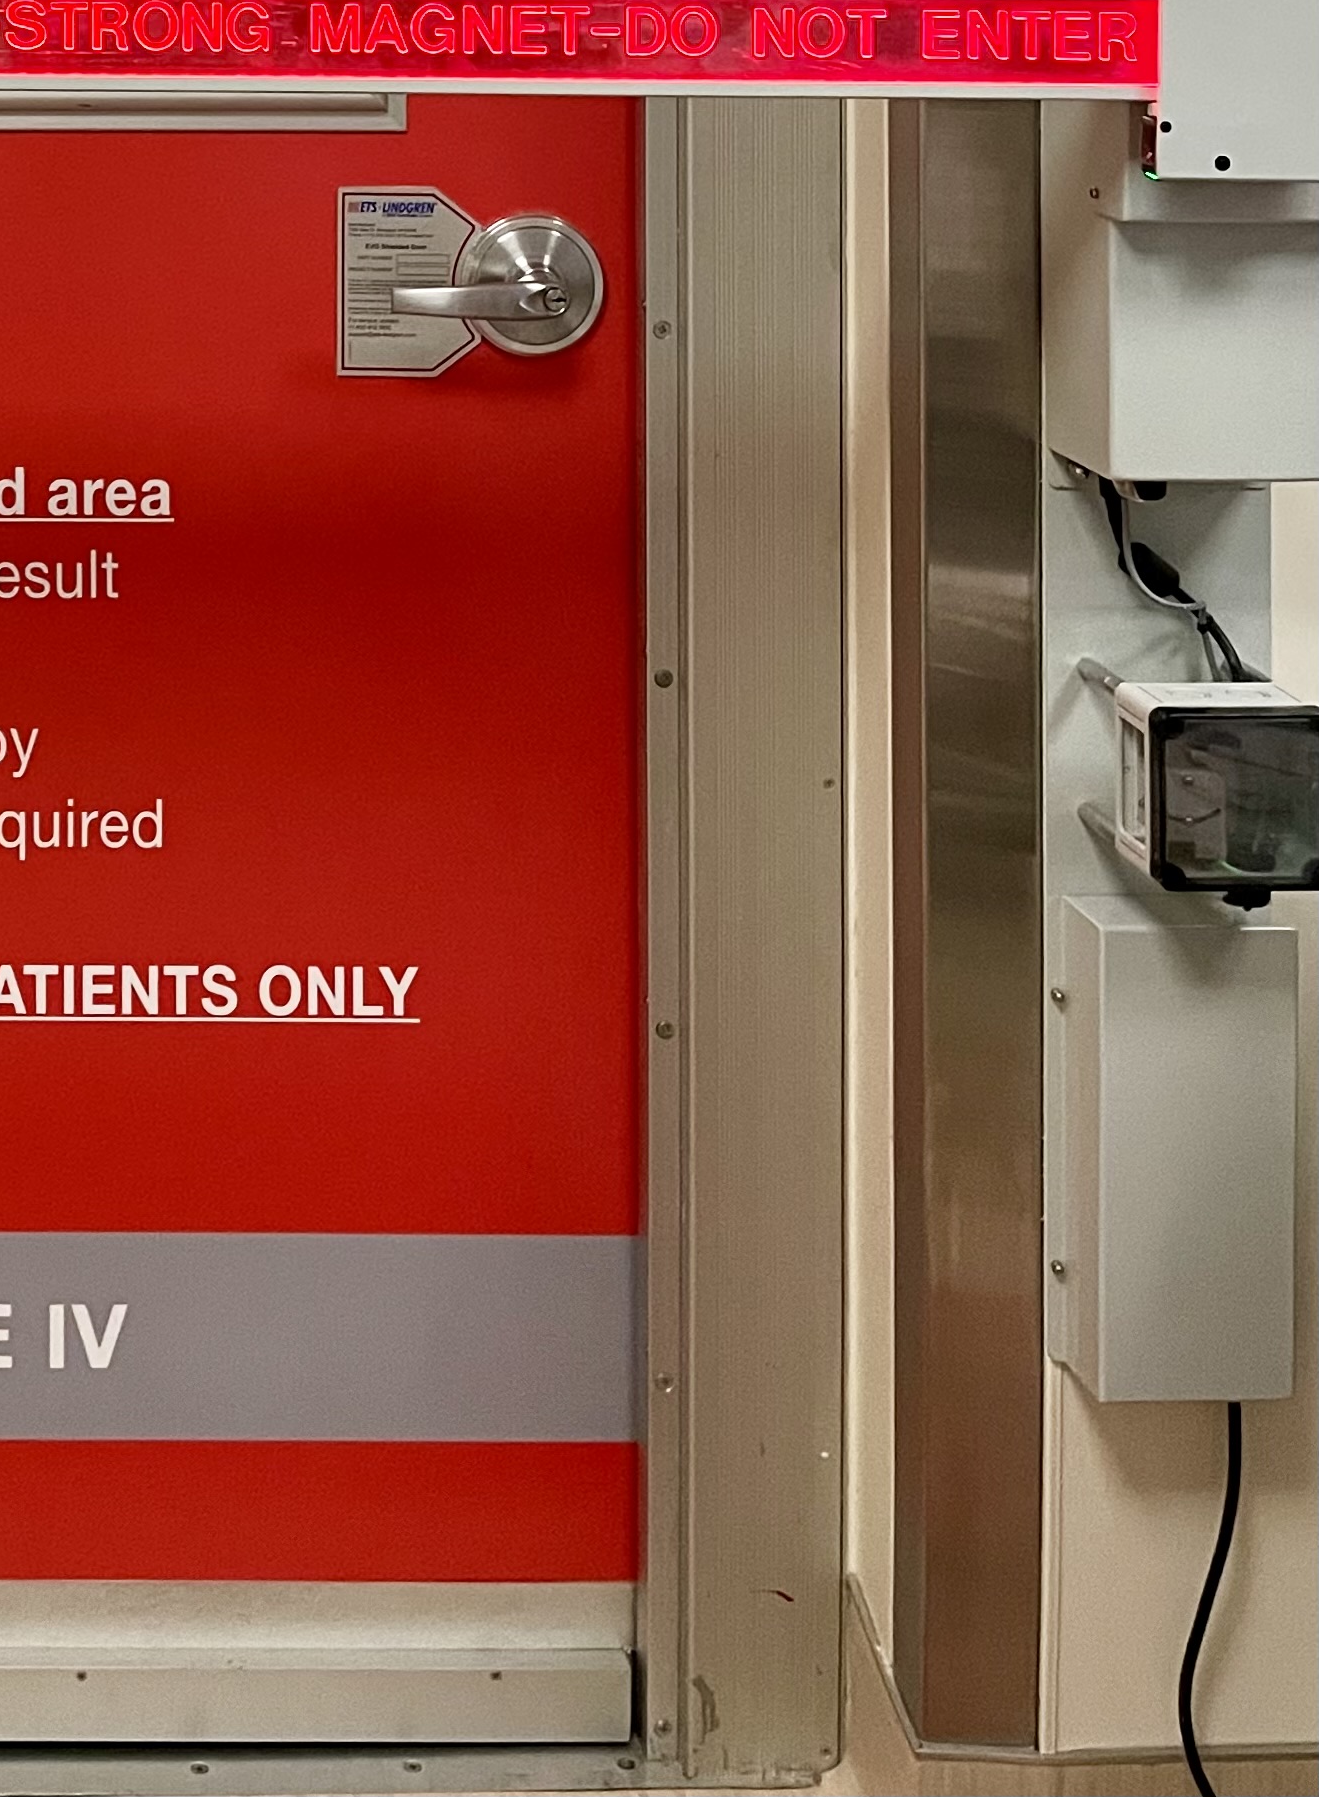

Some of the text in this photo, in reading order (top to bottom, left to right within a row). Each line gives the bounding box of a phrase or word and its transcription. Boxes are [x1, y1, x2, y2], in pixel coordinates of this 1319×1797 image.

[753, 6, 887, 59] NOT
[921, 9, 1139, 63] ENTER
[47, 478, 172, 516] area
[258, 964, 419, 1017] ONLY
[49, 1304, 128, 1369] IV
